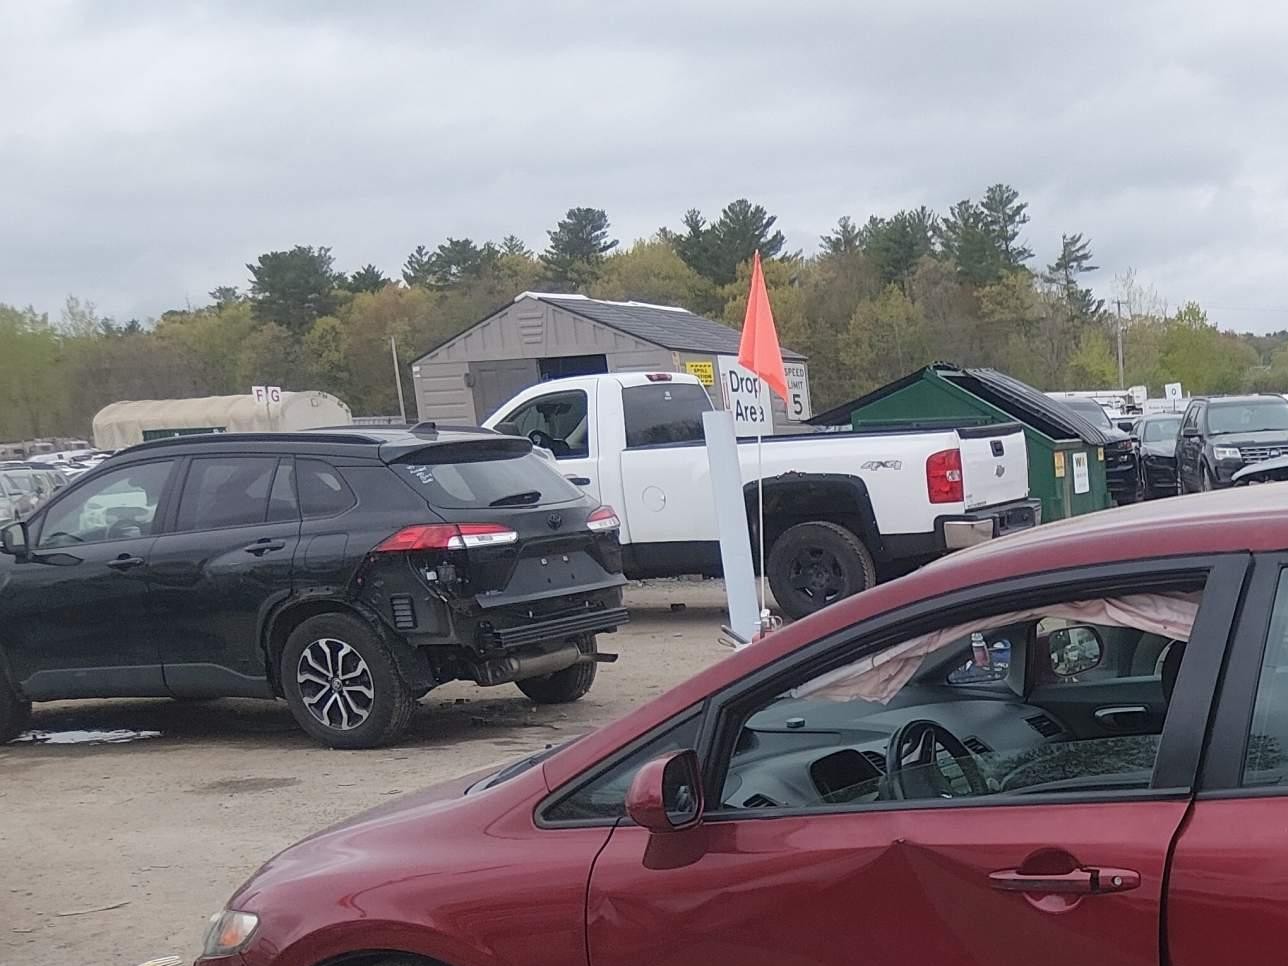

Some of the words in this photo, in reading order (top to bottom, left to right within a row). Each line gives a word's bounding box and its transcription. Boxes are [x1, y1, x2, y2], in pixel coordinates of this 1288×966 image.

[784, 367, 805, 378] SPEED
[787, 380, 804, 390] LIMIT
[256, 390, 263, 401] F
[271, 390, 279, 401] G
[792, 394, 803, 415] 5
[735, 400, 765, 423] Area
